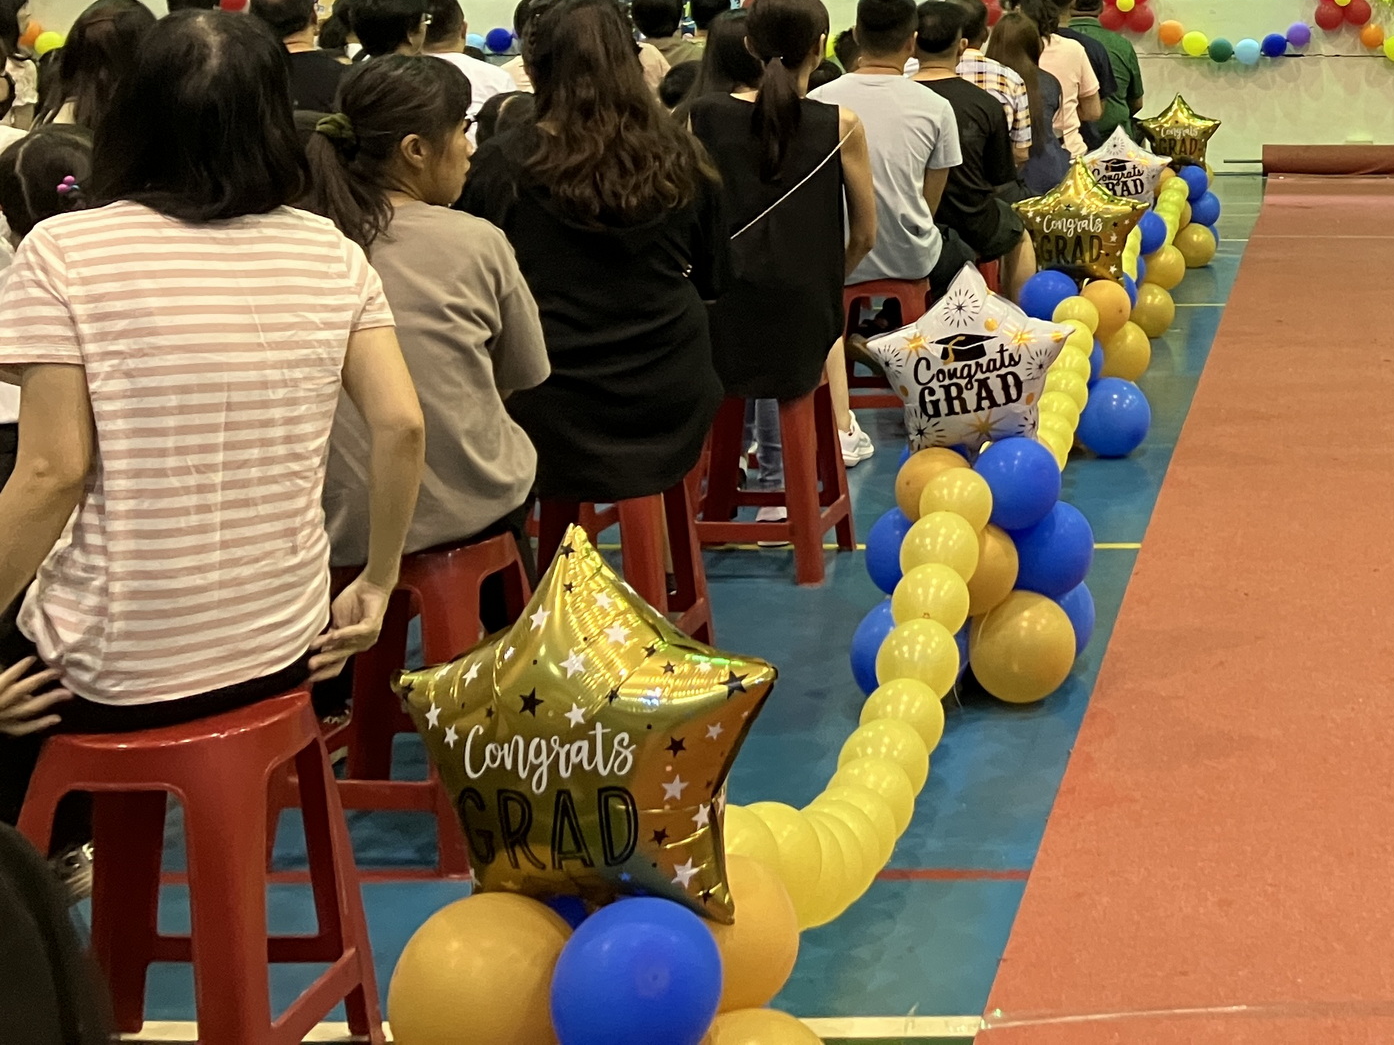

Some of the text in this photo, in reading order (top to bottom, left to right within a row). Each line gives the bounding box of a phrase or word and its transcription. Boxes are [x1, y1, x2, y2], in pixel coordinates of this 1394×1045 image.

[1105, 178, 1144, 197] RAD
[1043, 214, 1103, 237] Congrats
[1040, 234, 1103, 266] GRAD
[914, 343, 1021, 391] Congrats
[918, 371, 1023, 419] GRAD
[464, 721, 637, 794] Congrats
[457, 785, 639, 872] GRAD
